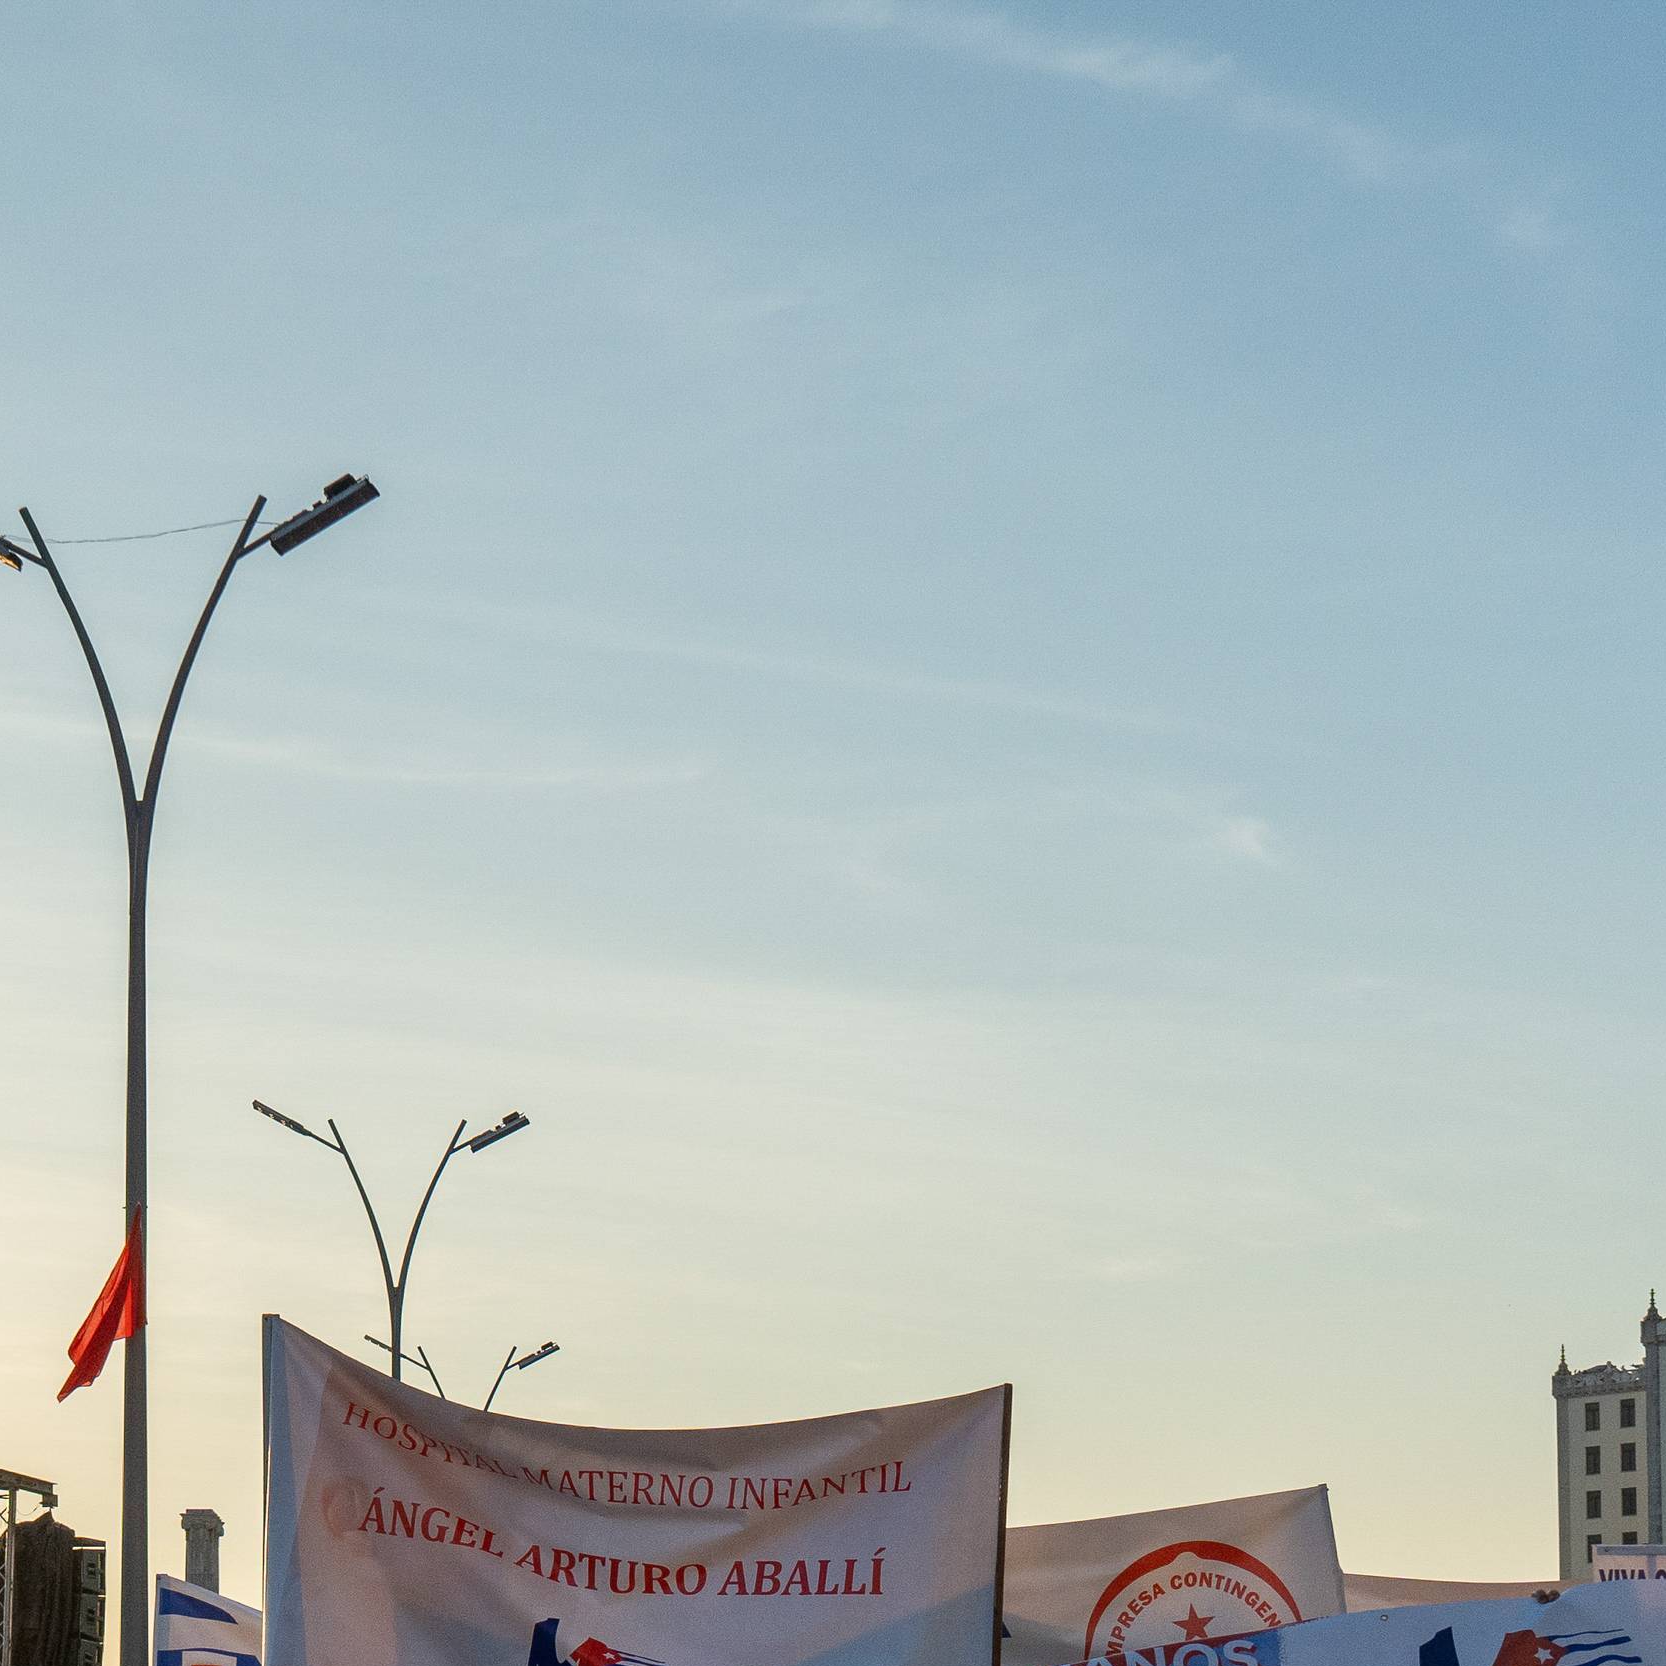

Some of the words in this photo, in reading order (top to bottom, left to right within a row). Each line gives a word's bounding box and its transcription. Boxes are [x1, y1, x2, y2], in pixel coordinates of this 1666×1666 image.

[343, 1402, 518, 1479] HOSPITAL
[521, 1466, 715, 1508] MATERNO
[725, 1460, 912, 1510] INFANTIL
[358, 1487, 504, 1558] ÁNGEL
[514, 1544, 708, 1596] ARTURO
[717, 1547, 886, 1596] ABALLÍ
[1105, 1583, 1166, 1656] MPRESA
[1170, 1572, 1282, 1627] CONTINGEN
